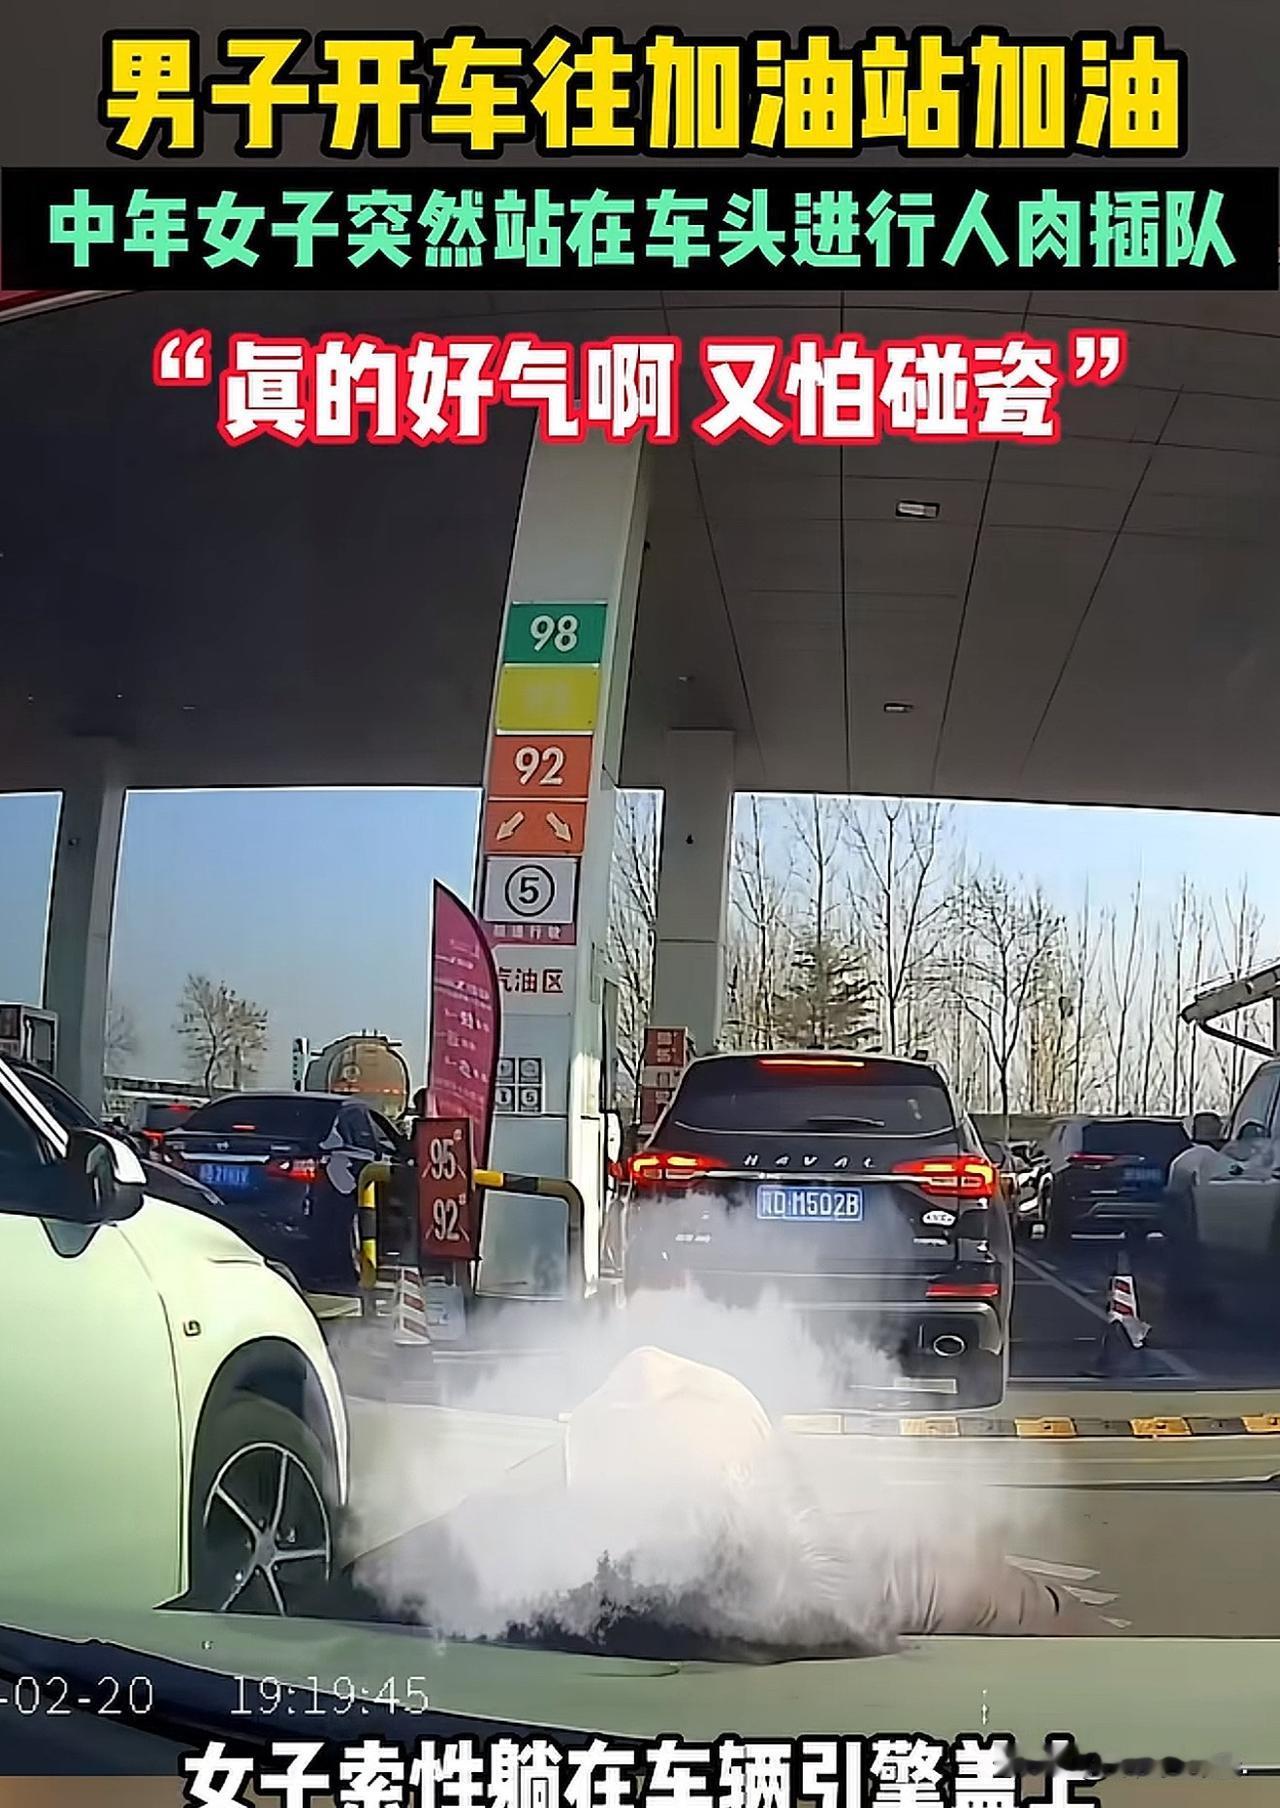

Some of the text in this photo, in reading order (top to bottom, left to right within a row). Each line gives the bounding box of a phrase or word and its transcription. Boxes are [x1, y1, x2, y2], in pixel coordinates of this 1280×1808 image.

[531, 615, 578, 652] 98
[515, 746, 565, 785] 92
[519, 876, 540, 904] 5
[430, 1138, 456, 1180] 95
[743, 1154, 877, 1168] HAVAL
[433, 1198, 460, 1241] 92
